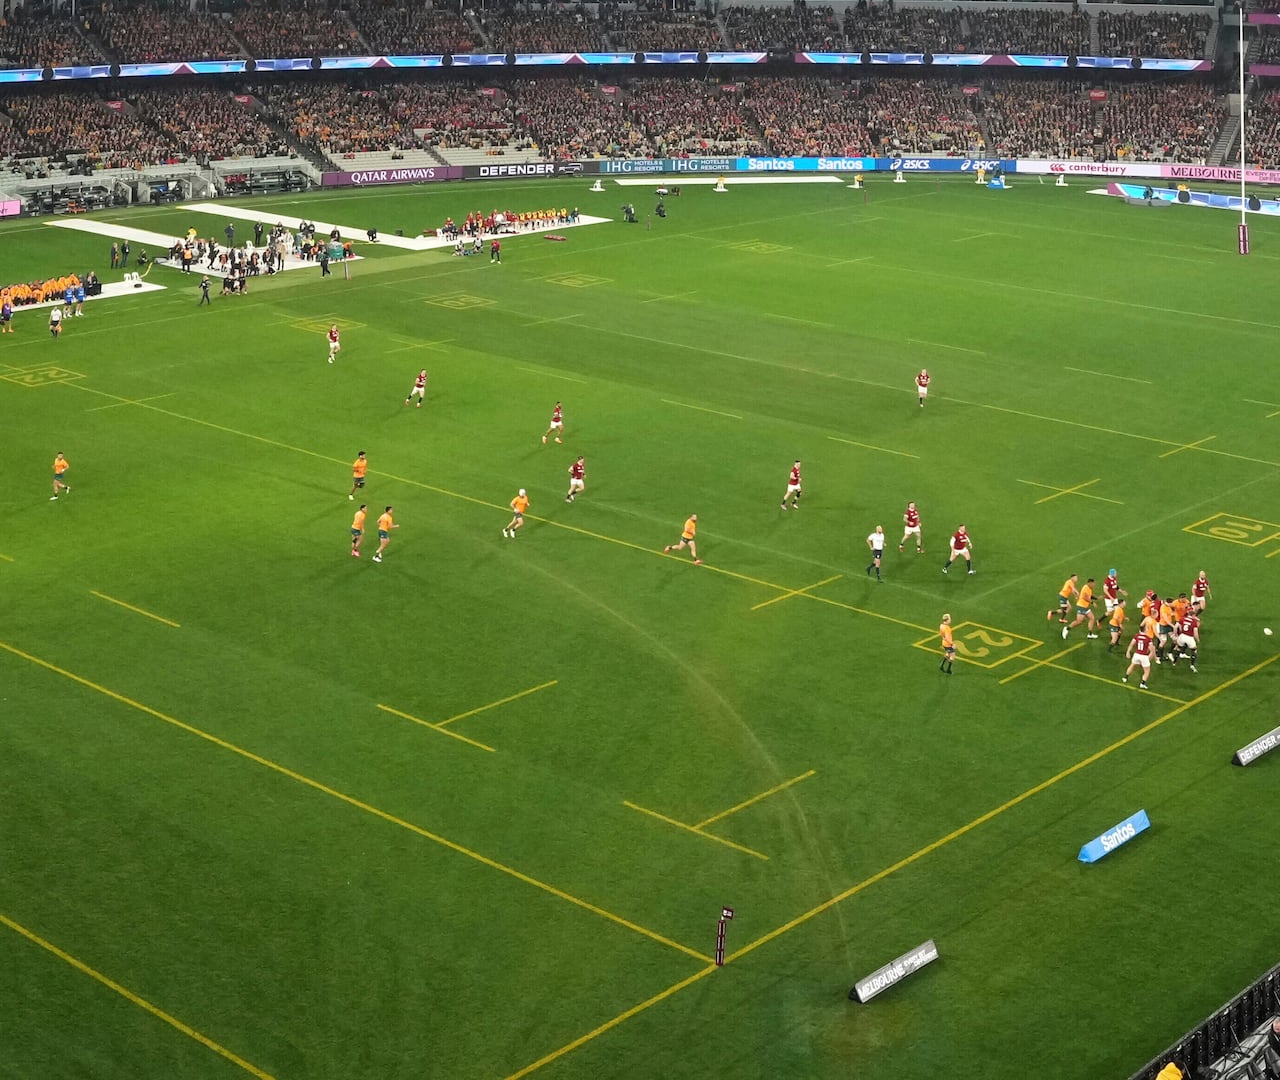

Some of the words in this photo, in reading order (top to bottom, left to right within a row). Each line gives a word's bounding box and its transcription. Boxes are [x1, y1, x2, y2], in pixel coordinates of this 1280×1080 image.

[480, 164, 554, 176] DEFENDER
[606, 161, 632, 173] IHG
[672, 159, 698, 171] IHG
[748, 159, 794, 170] Santos
[818, 159, 863, 170] Santos
[1069, 163, 1127, 175] canterbury
[351, 170, 387, 183] QATAR
[391, 168, 435, 180] AIRWAYS
[1170, 167, 1242, 180] MELBOURNE
[1208, 521, 1263, 539] 10
[953, 629, 1014, 658] 22
[1137, 640, 1145, 651] 11
[1239, 734, 1277, 763] DEFENDER
[1100, 822, 1136, 853] Santos
[857, 964, 906, 999] MELBOURNE
